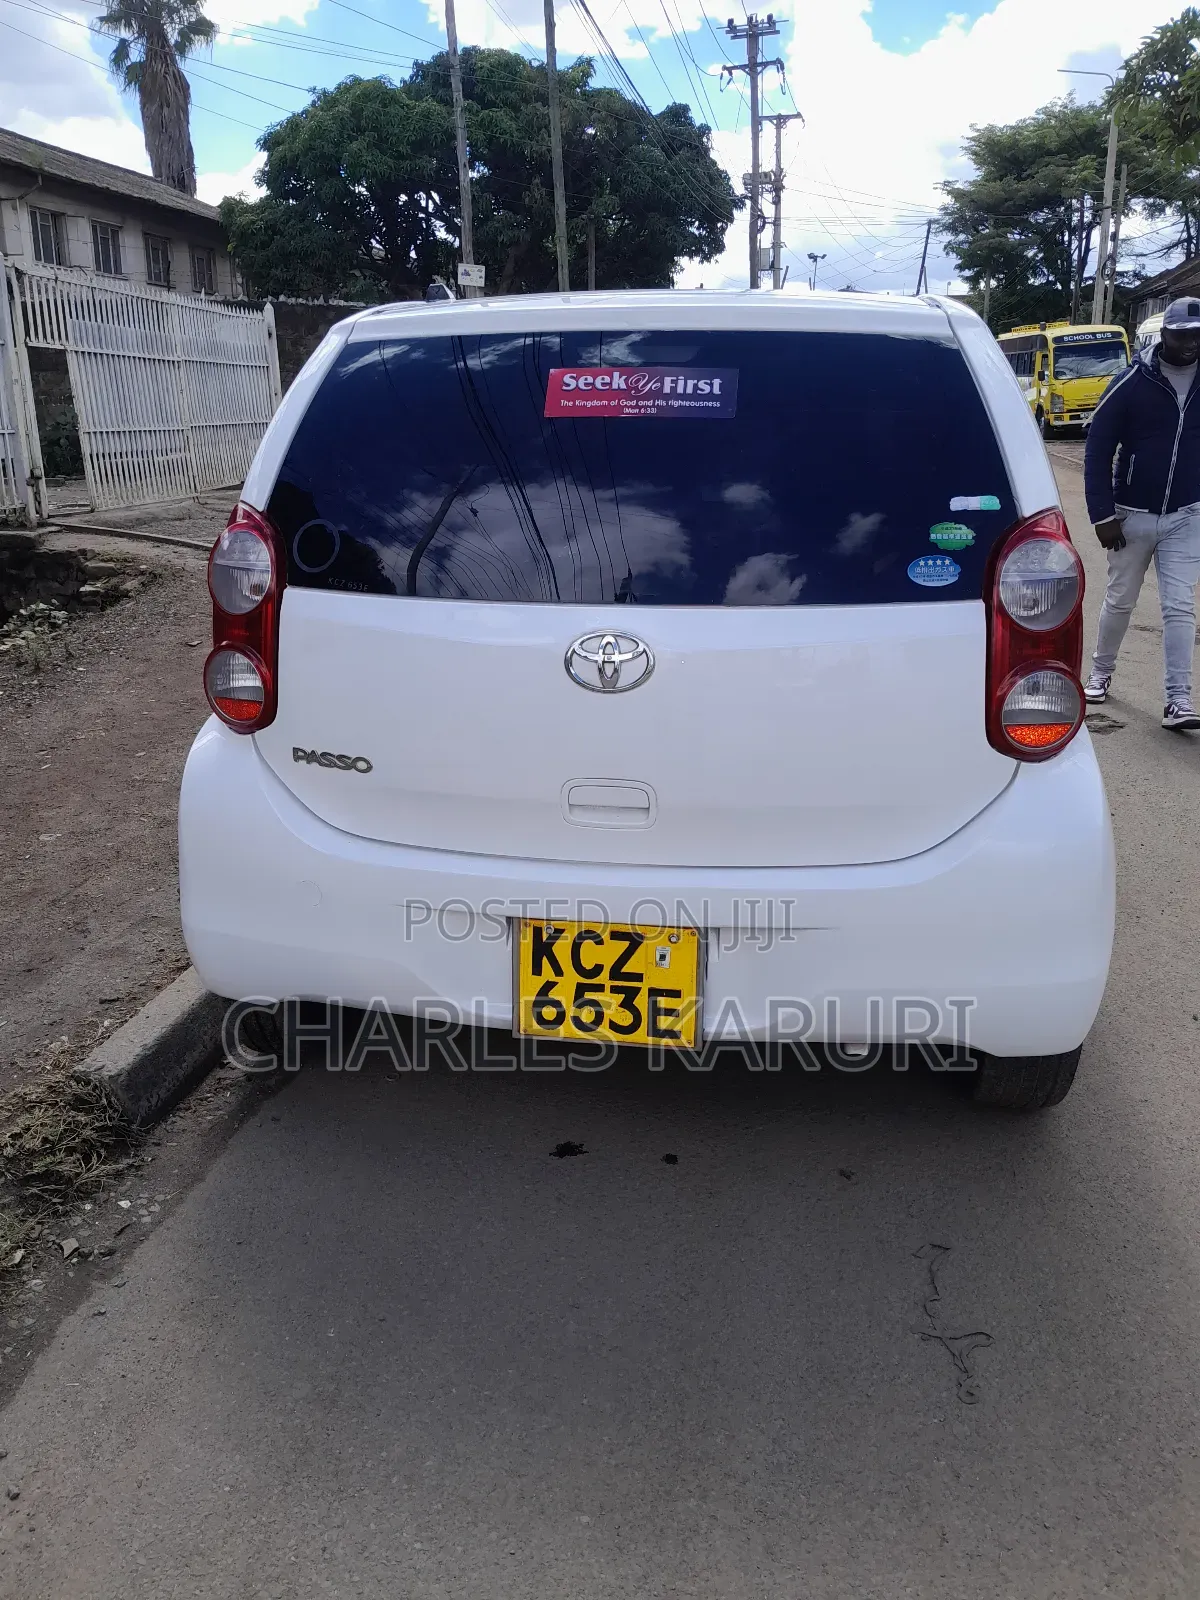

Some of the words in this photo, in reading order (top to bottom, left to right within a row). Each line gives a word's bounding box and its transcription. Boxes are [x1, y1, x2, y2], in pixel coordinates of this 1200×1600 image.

[1063, 334, 1095, 342] SCHOOL
[561, 372, 627, 391] Seek
[628, 372, 661, 396] Ye
[662, 376, 723, 395] First
[560, 399, 574, 407] The
[575, 399, 608, 408] Kingdom
[654, 399, 667, 407] His
[668, 399, 721, 408] righteousness
[327, 577, 347, 587] KCZ
[292, 746, 374, 774] PASSO
[531, 924, 645, 983] KCZ
[531, 979, 682, 1040] 653E
